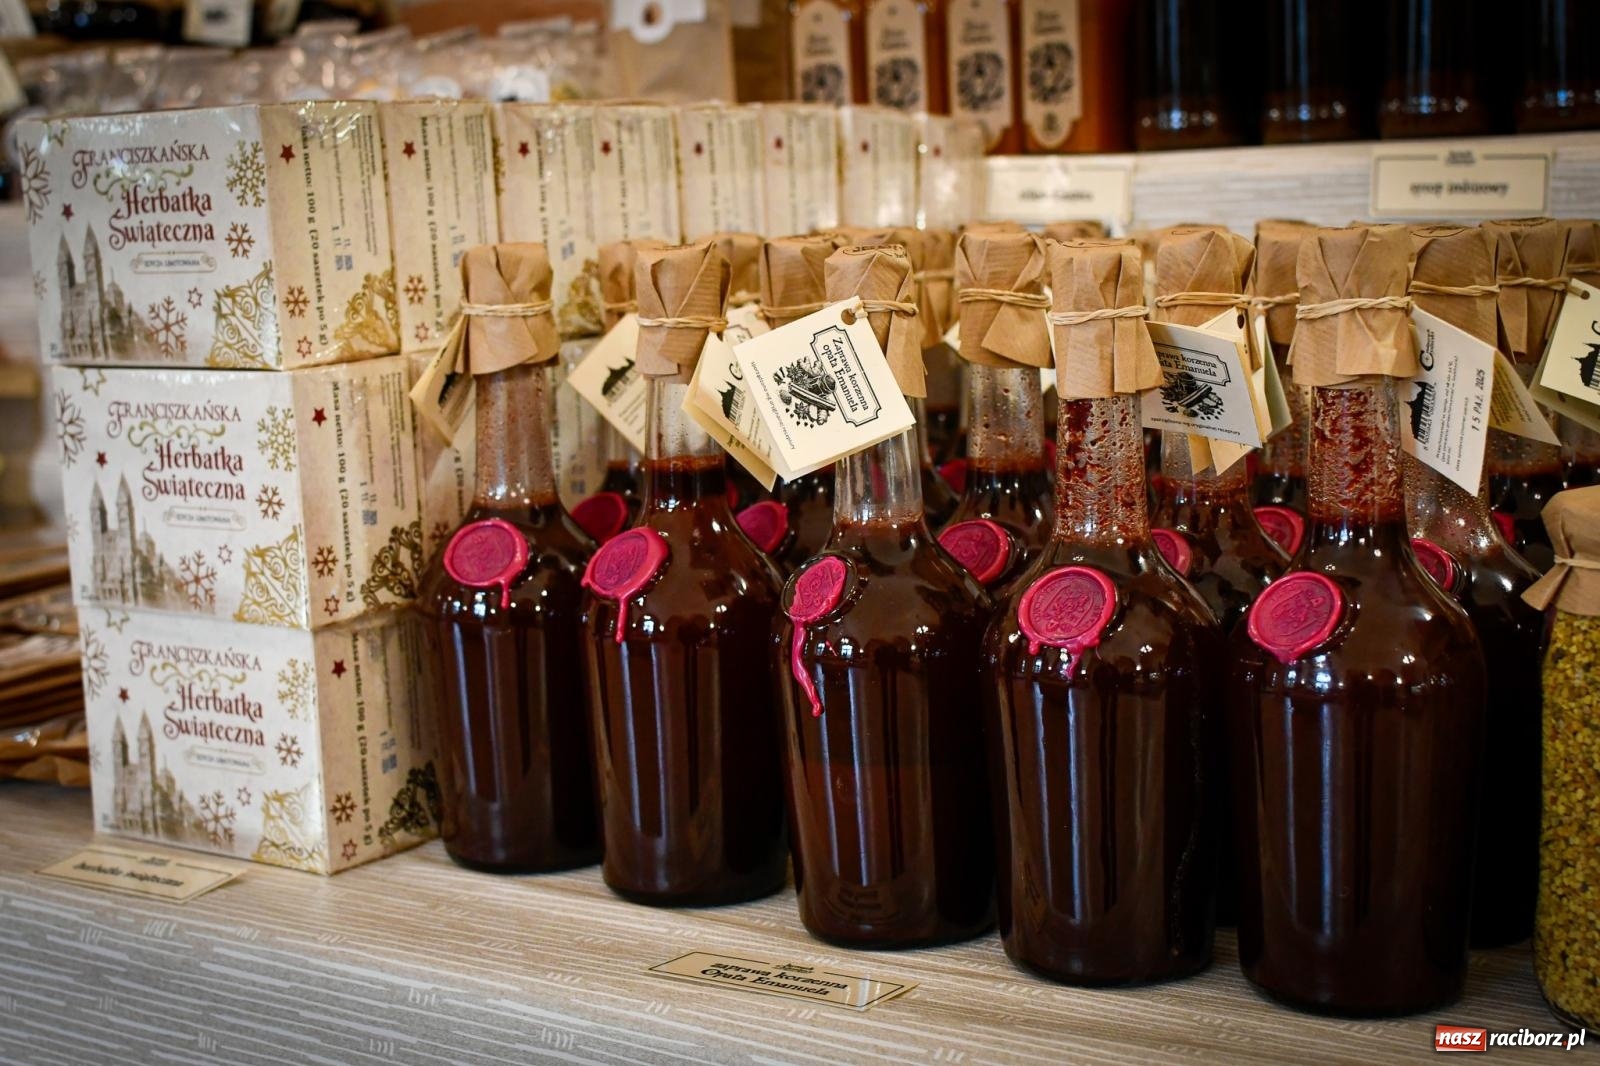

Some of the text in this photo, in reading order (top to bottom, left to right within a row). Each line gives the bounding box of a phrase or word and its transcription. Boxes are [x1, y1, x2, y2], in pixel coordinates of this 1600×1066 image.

[72, 140, 209, 189] FRANCISZKAŃSKA
[303, 152, 312, 188] netto:
[117, 186, 214, 218] Herbatka
[307, 191, 316, 214] 100
[109, 213, 215, 250] Świąteczna
[307, 216, 316, 226] g
[309, 228, 319, 250] (20
[312, 253, 325, 305] saszetek
[316, 307, 325, 322] po
[319, 323, 327, 332] 5
[318, 334, 329, 346] g)
[832, 337, 869, 411] Zaprawa korzenna
[1174, 360, 1217, 377] Emanuela
[1181, 353, 1217, 369] korzenna
[821, 344, 858, 412] opata Emanuela
[332, 381, 340, 411] Masa
[107, 400, 240, 439] FRANCISZKAŃSKA
[335, 414, 343, 449] netto:
[146, 440, 244, 476] Herbatka
[338, 452, 347, 475] 100
[142, 461, 246, 502] Świąteczna
[338, 476, 346, 485] g
[339, 488, 349, 509] (20
[342, 511, 352, 564] saszetek
[345, 565, 352, 580] po
[129, 640, 262, 676] FRANCISZKAŃSKA
[169, 682, 264, 720] Herbatka
[163, 702, 265, 747] Świąteczna
[701, 968, 830, 996] Opata Emanuela
[710, 963, 772, 977] zaprawa
[774, 971, 849, 989] korzenna
